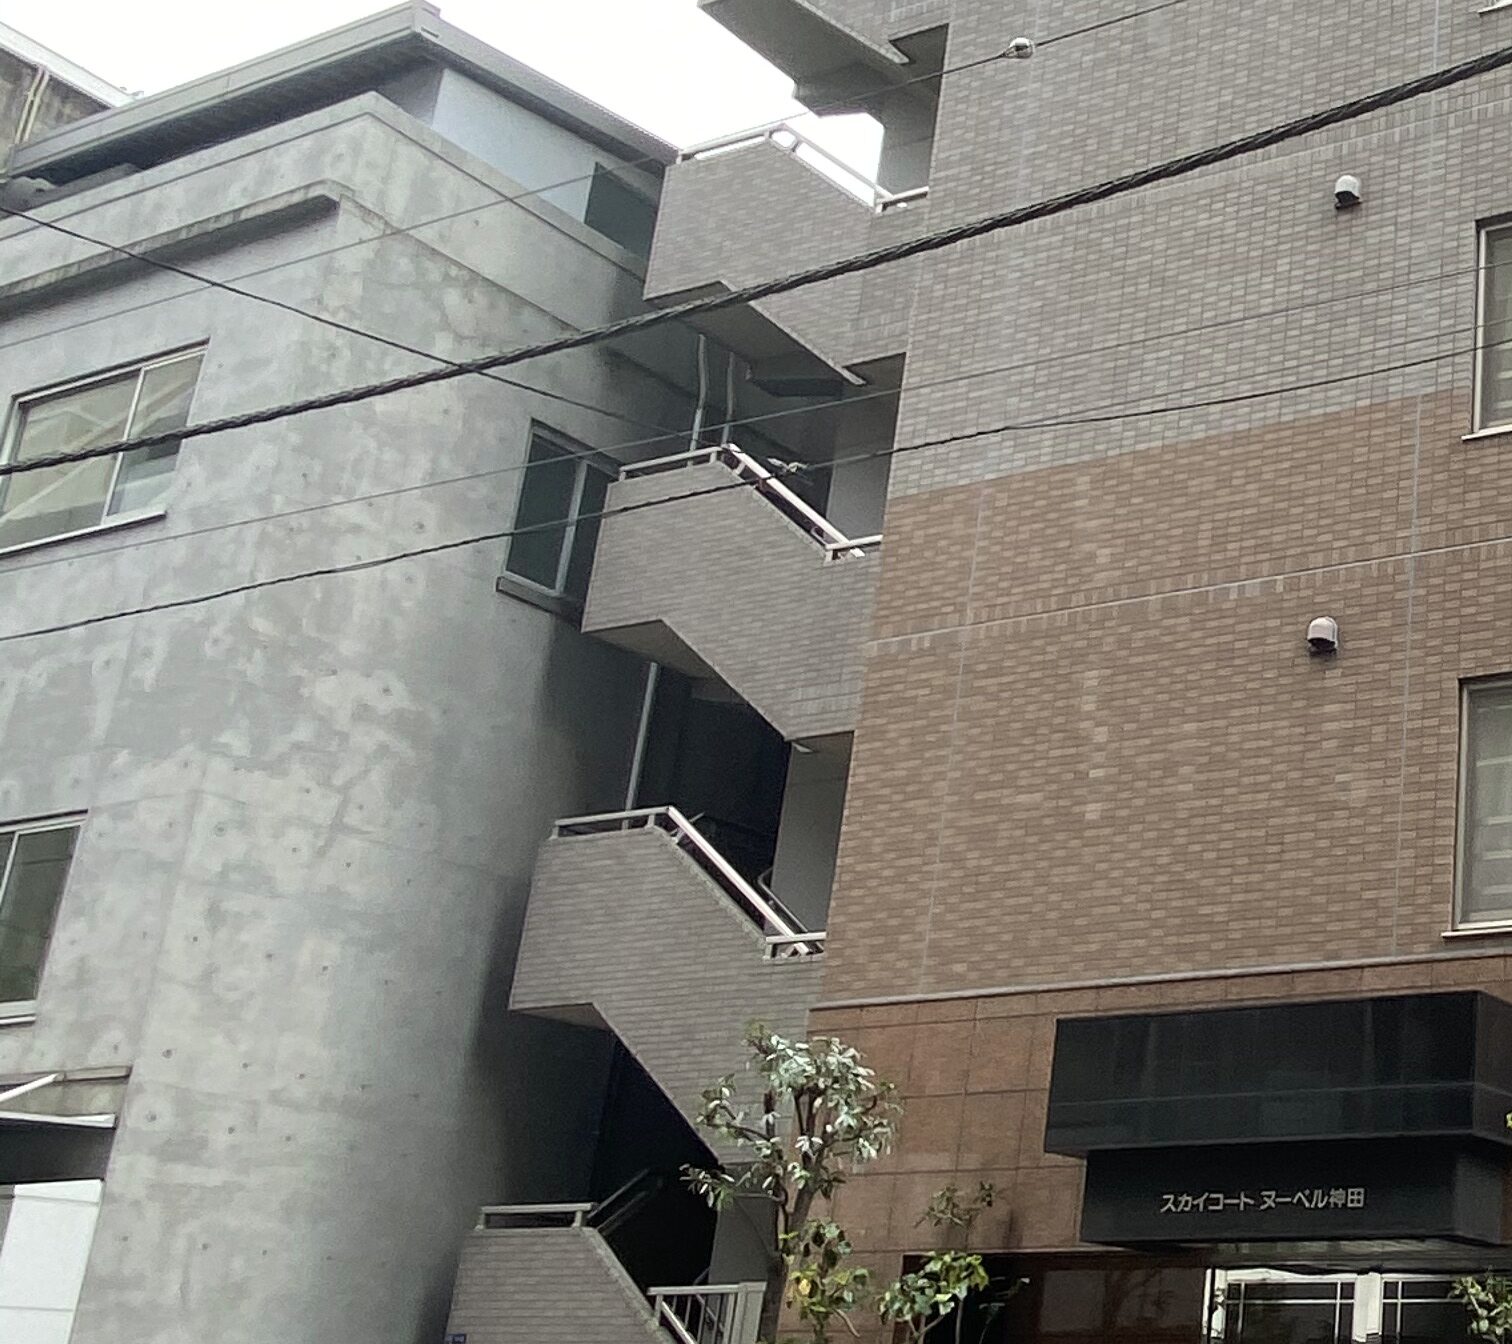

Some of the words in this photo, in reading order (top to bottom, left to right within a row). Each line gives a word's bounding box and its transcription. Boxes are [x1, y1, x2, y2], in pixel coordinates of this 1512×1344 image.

[1160, 1191, 1255, 1213] スカイコート
[1259, 1188, 1365, 1210] ヌーベル神田
